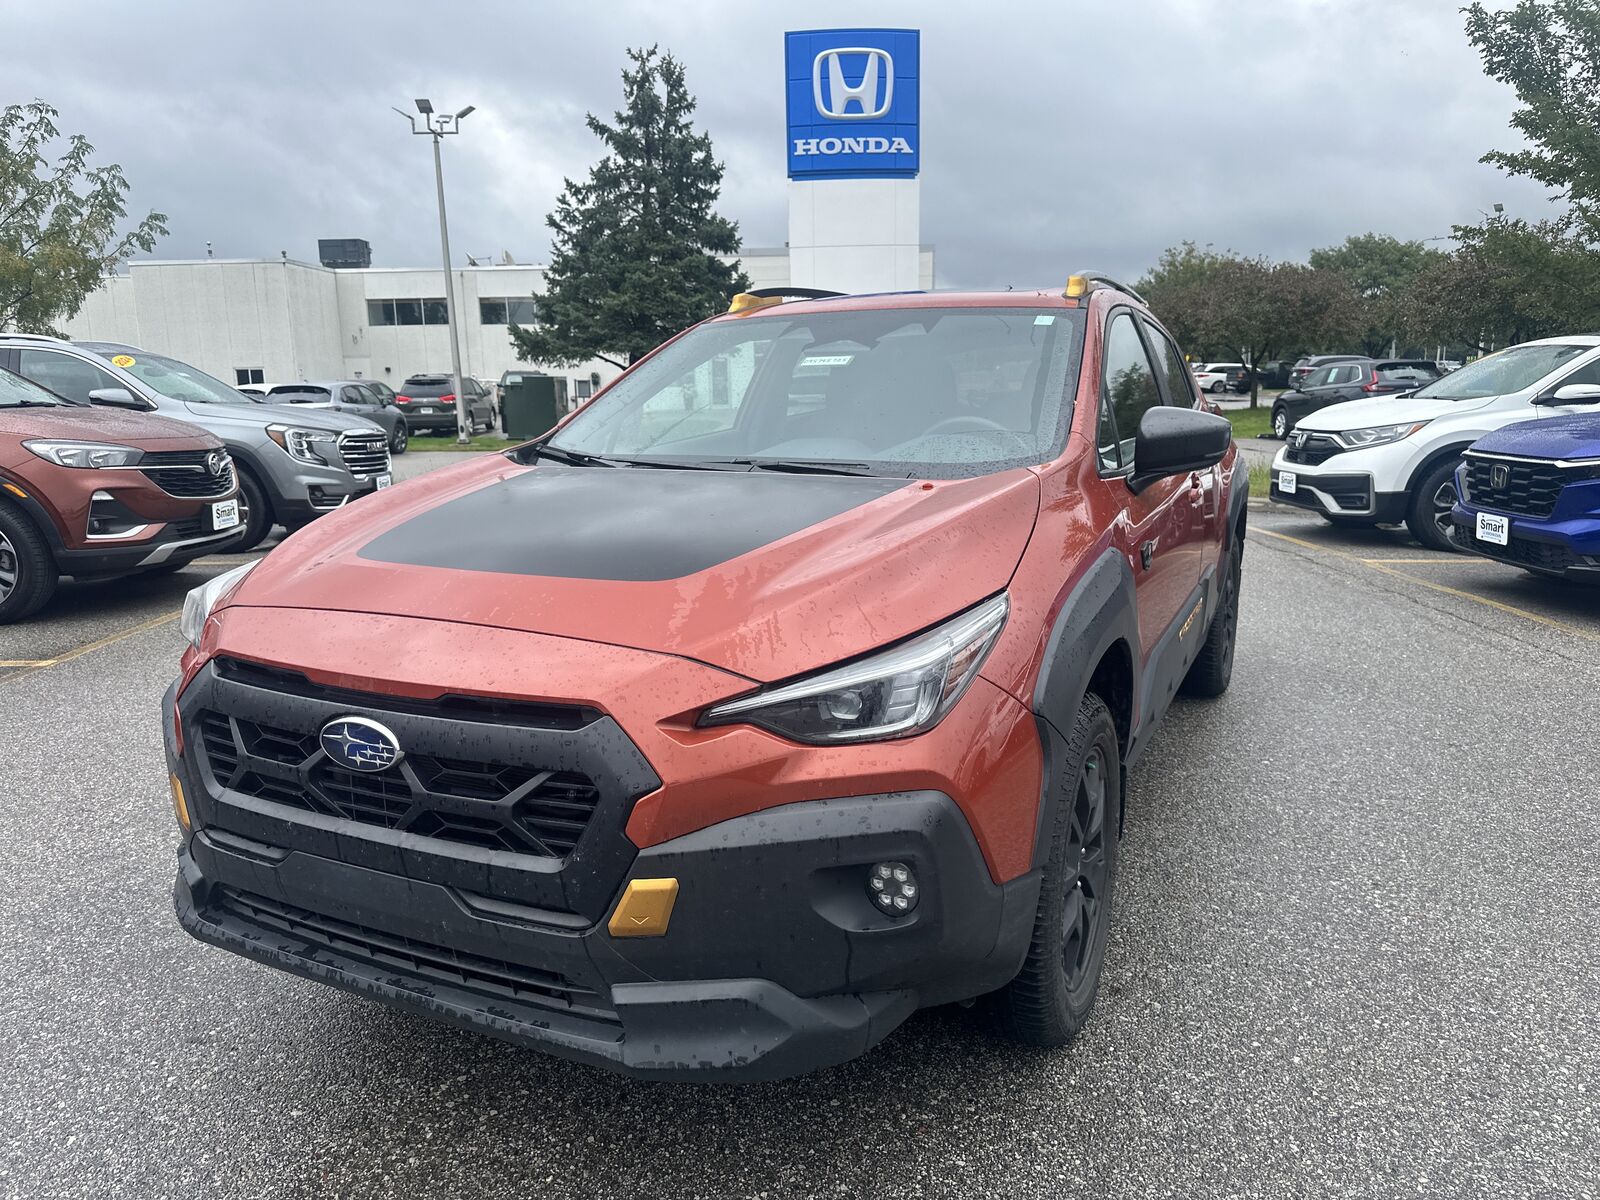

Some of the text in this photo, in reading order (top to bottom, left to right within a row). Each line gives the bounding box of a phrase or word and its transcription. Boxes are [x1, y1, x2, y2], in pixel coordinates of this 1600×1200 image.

[793, 137, 914, 156] HONDA
[216, 506, 235, 518] Smart
[1480, 519, 1504, 533] Smart
